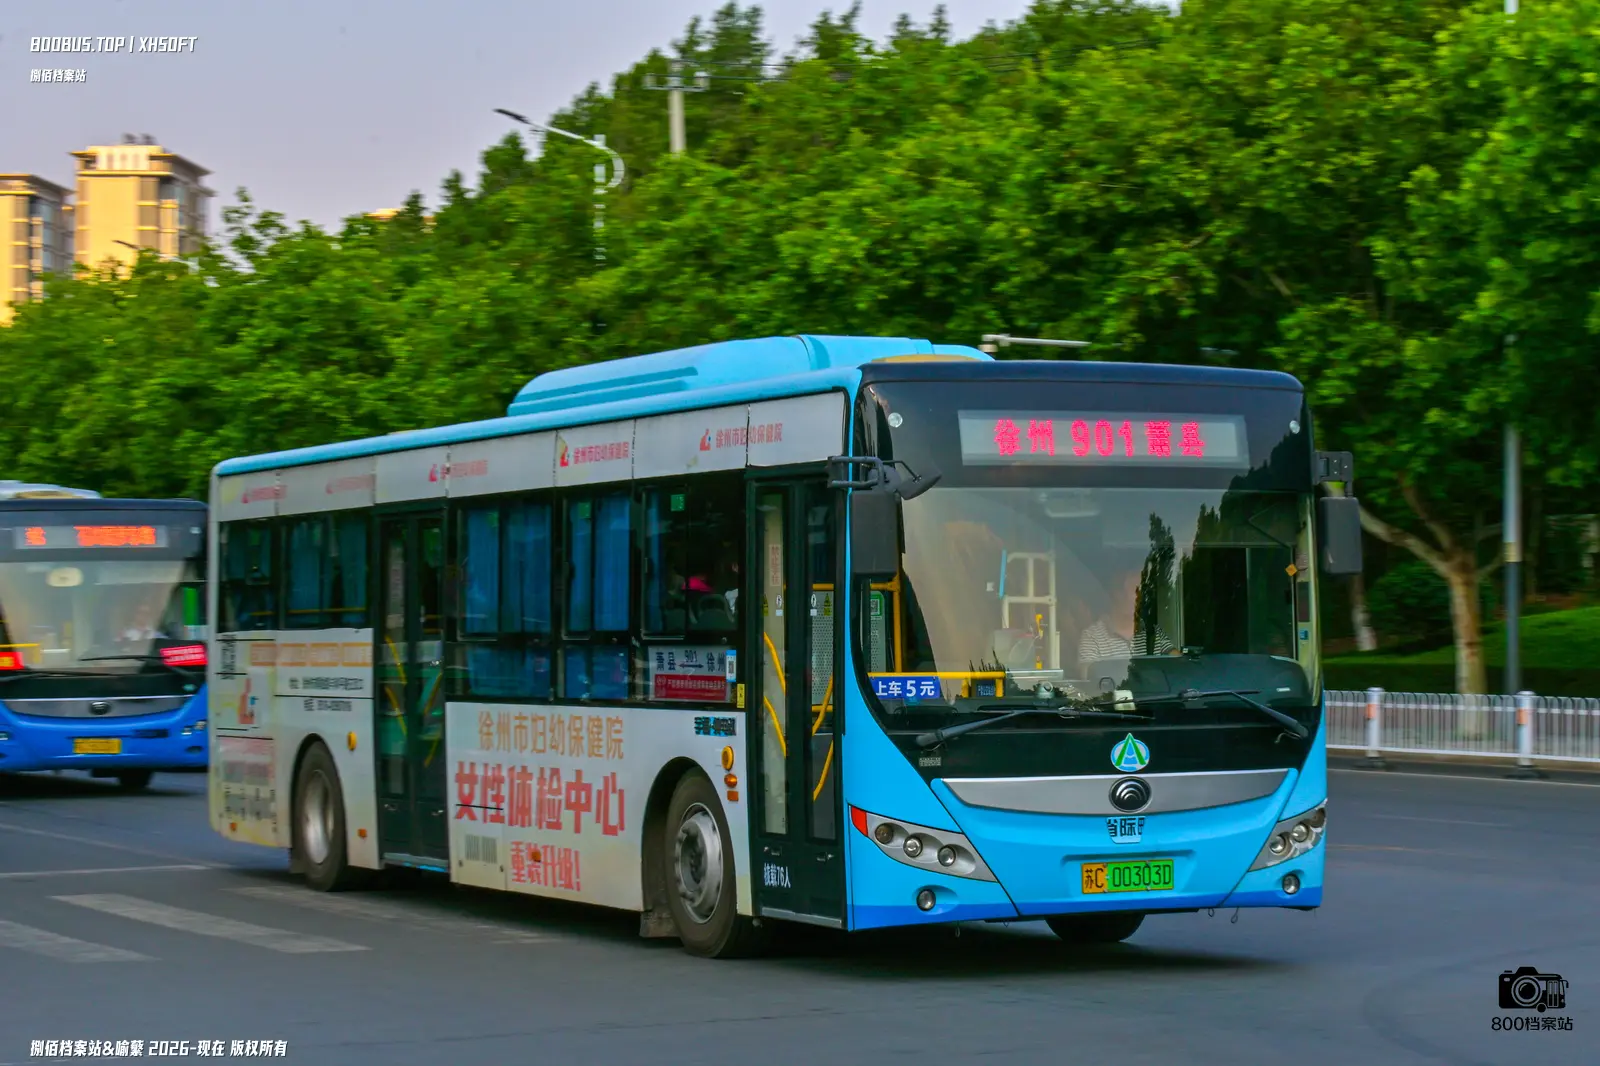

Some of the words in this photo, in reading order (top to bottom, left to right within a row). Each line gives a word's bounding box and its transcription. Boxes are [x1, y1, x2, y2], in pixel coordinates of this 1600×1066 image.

[994, 419, 1054, 456] 徐州
[1071, 420, 1133, 457] 901
[1145, 420, 1205, 457] 萧县
[684, 650, 698, 663] 901
[478, 711, 624, 760] 徐州市妇幼保健院
[455, 761, 625, 836] 女性体检中心
[763, 862, 792, 889] 核载76人
